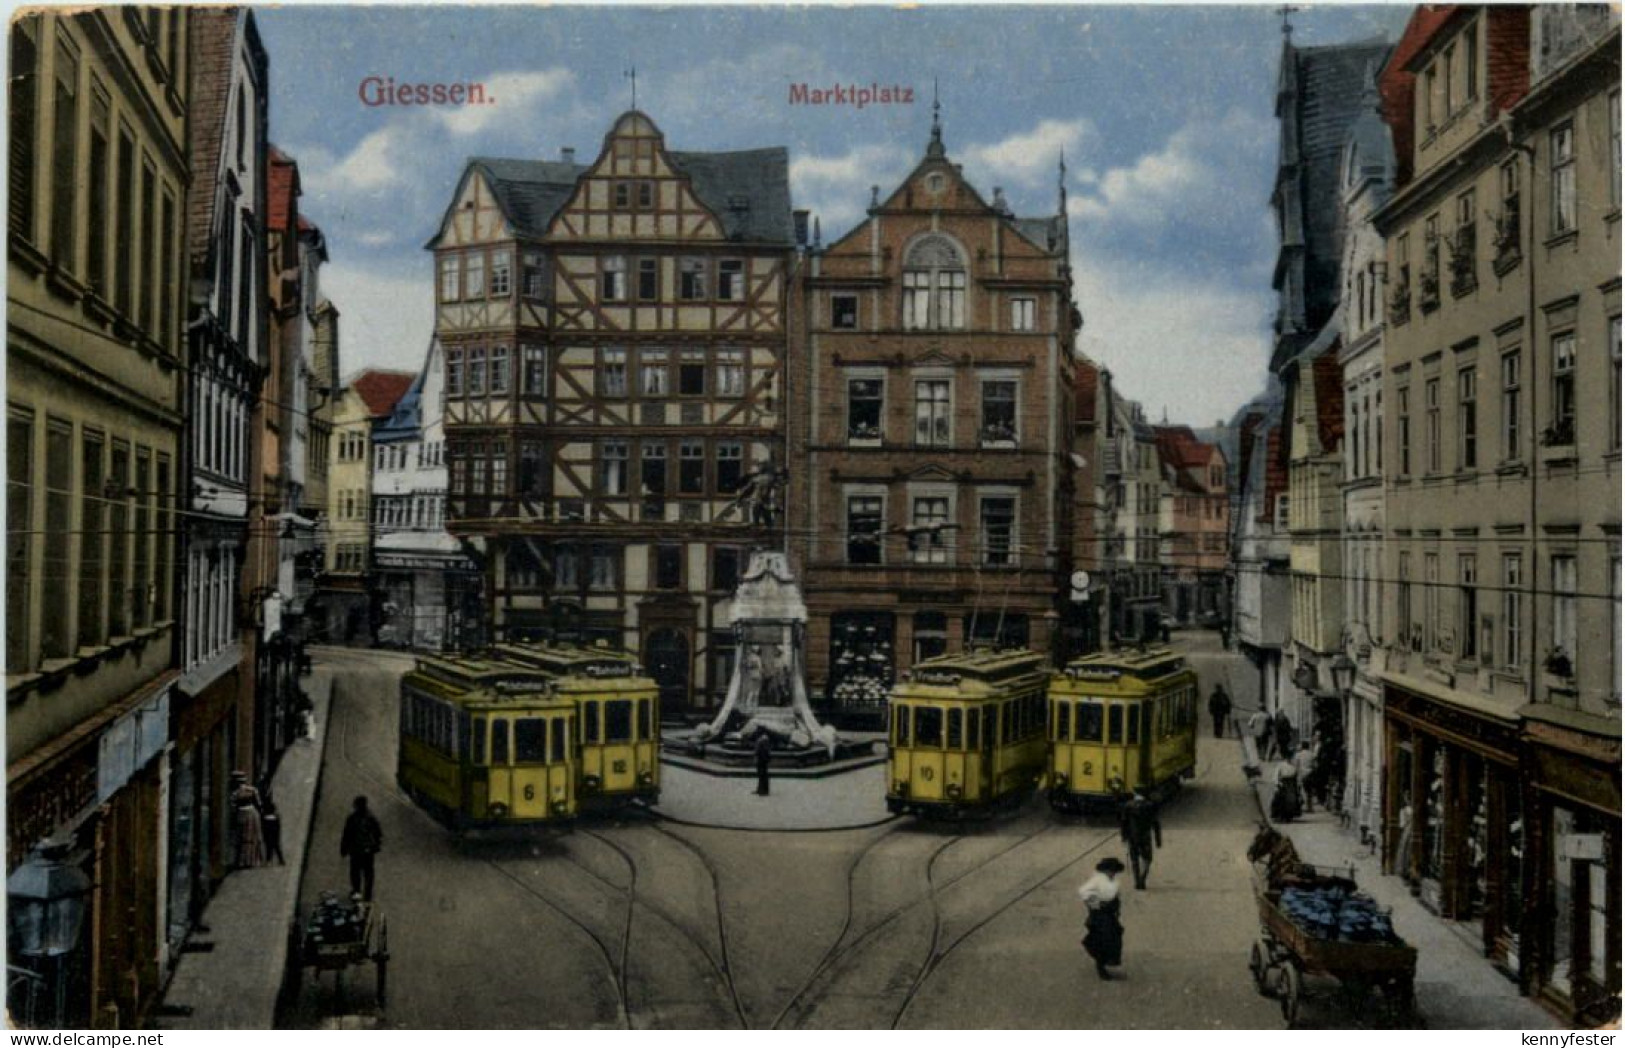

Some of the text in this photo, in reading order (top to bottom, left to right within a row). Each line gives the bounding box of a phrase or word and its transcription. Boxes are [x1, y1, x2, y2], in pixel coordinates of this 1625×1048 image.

[920, 766, 934, 783] 10
[1081, 760, 1093, 776] 2
[523, 783, 535, 801] 6
